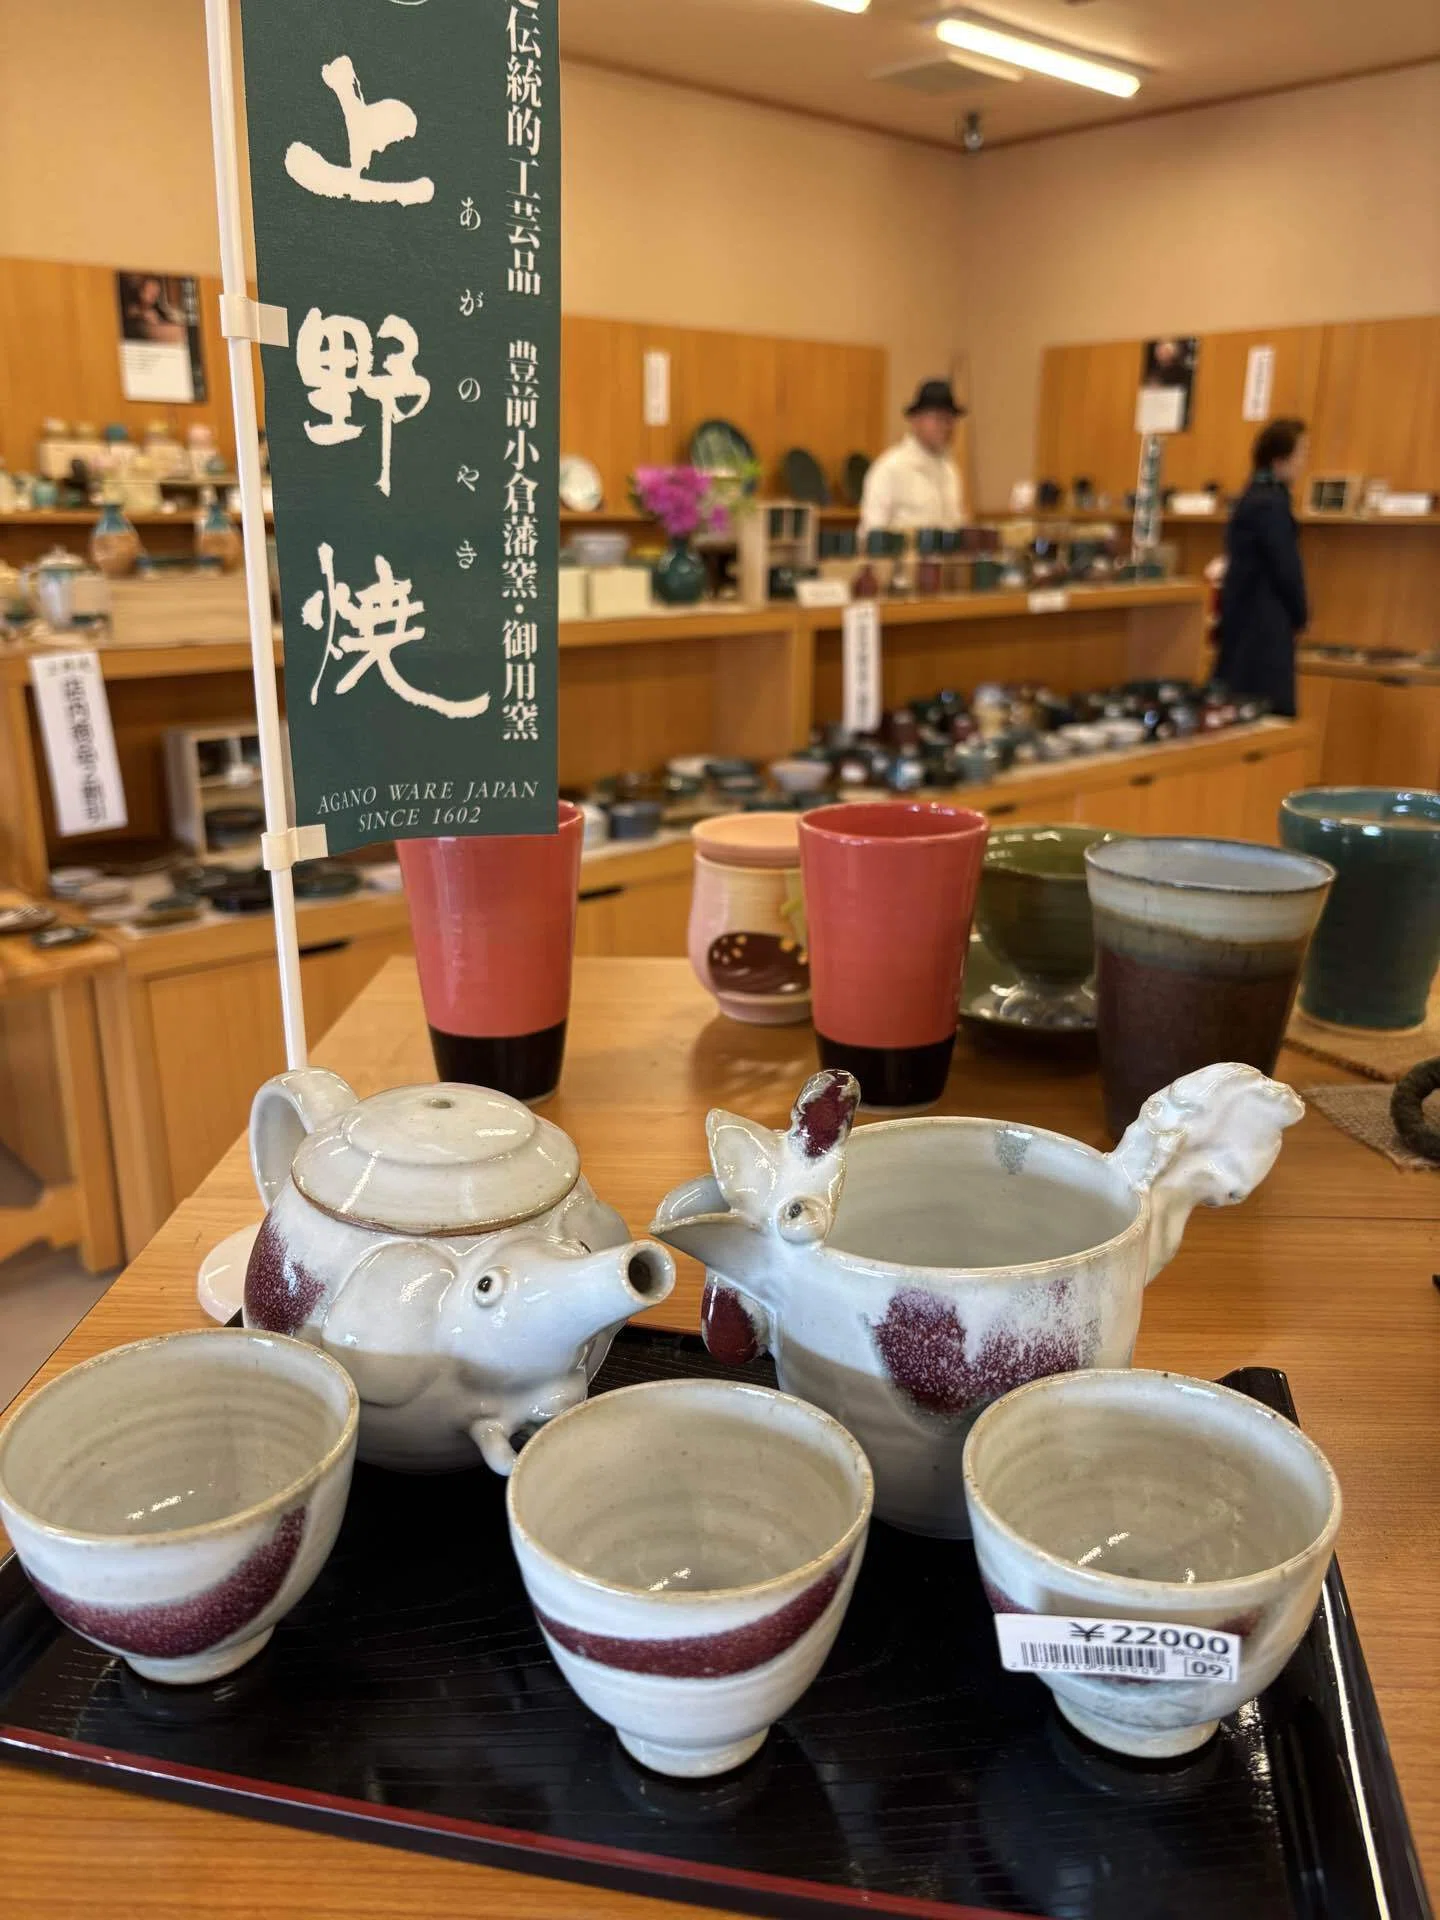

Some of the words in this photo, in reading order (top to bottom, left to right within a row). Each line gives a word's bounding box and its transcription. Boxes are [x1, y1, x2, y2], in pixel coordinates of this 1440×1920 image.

[505, 0, 542, 296] 伝統的工芸品
[284, 55, 491, 719] 上野焼
[455, 197, 484, 570] あがのやき
[502, 340, 541, 741] 豊前小倉藩窯・御用窯
[317, 786, 377, 815] AGANO
[389, 782, 453, 801] WARE
[463, 781, 539, 802] JAPAN
[358, 808, 420, 832] SINCE
[432, 806, 481, 825] 1602
[1192, 1661, 1224, 1676] 09
